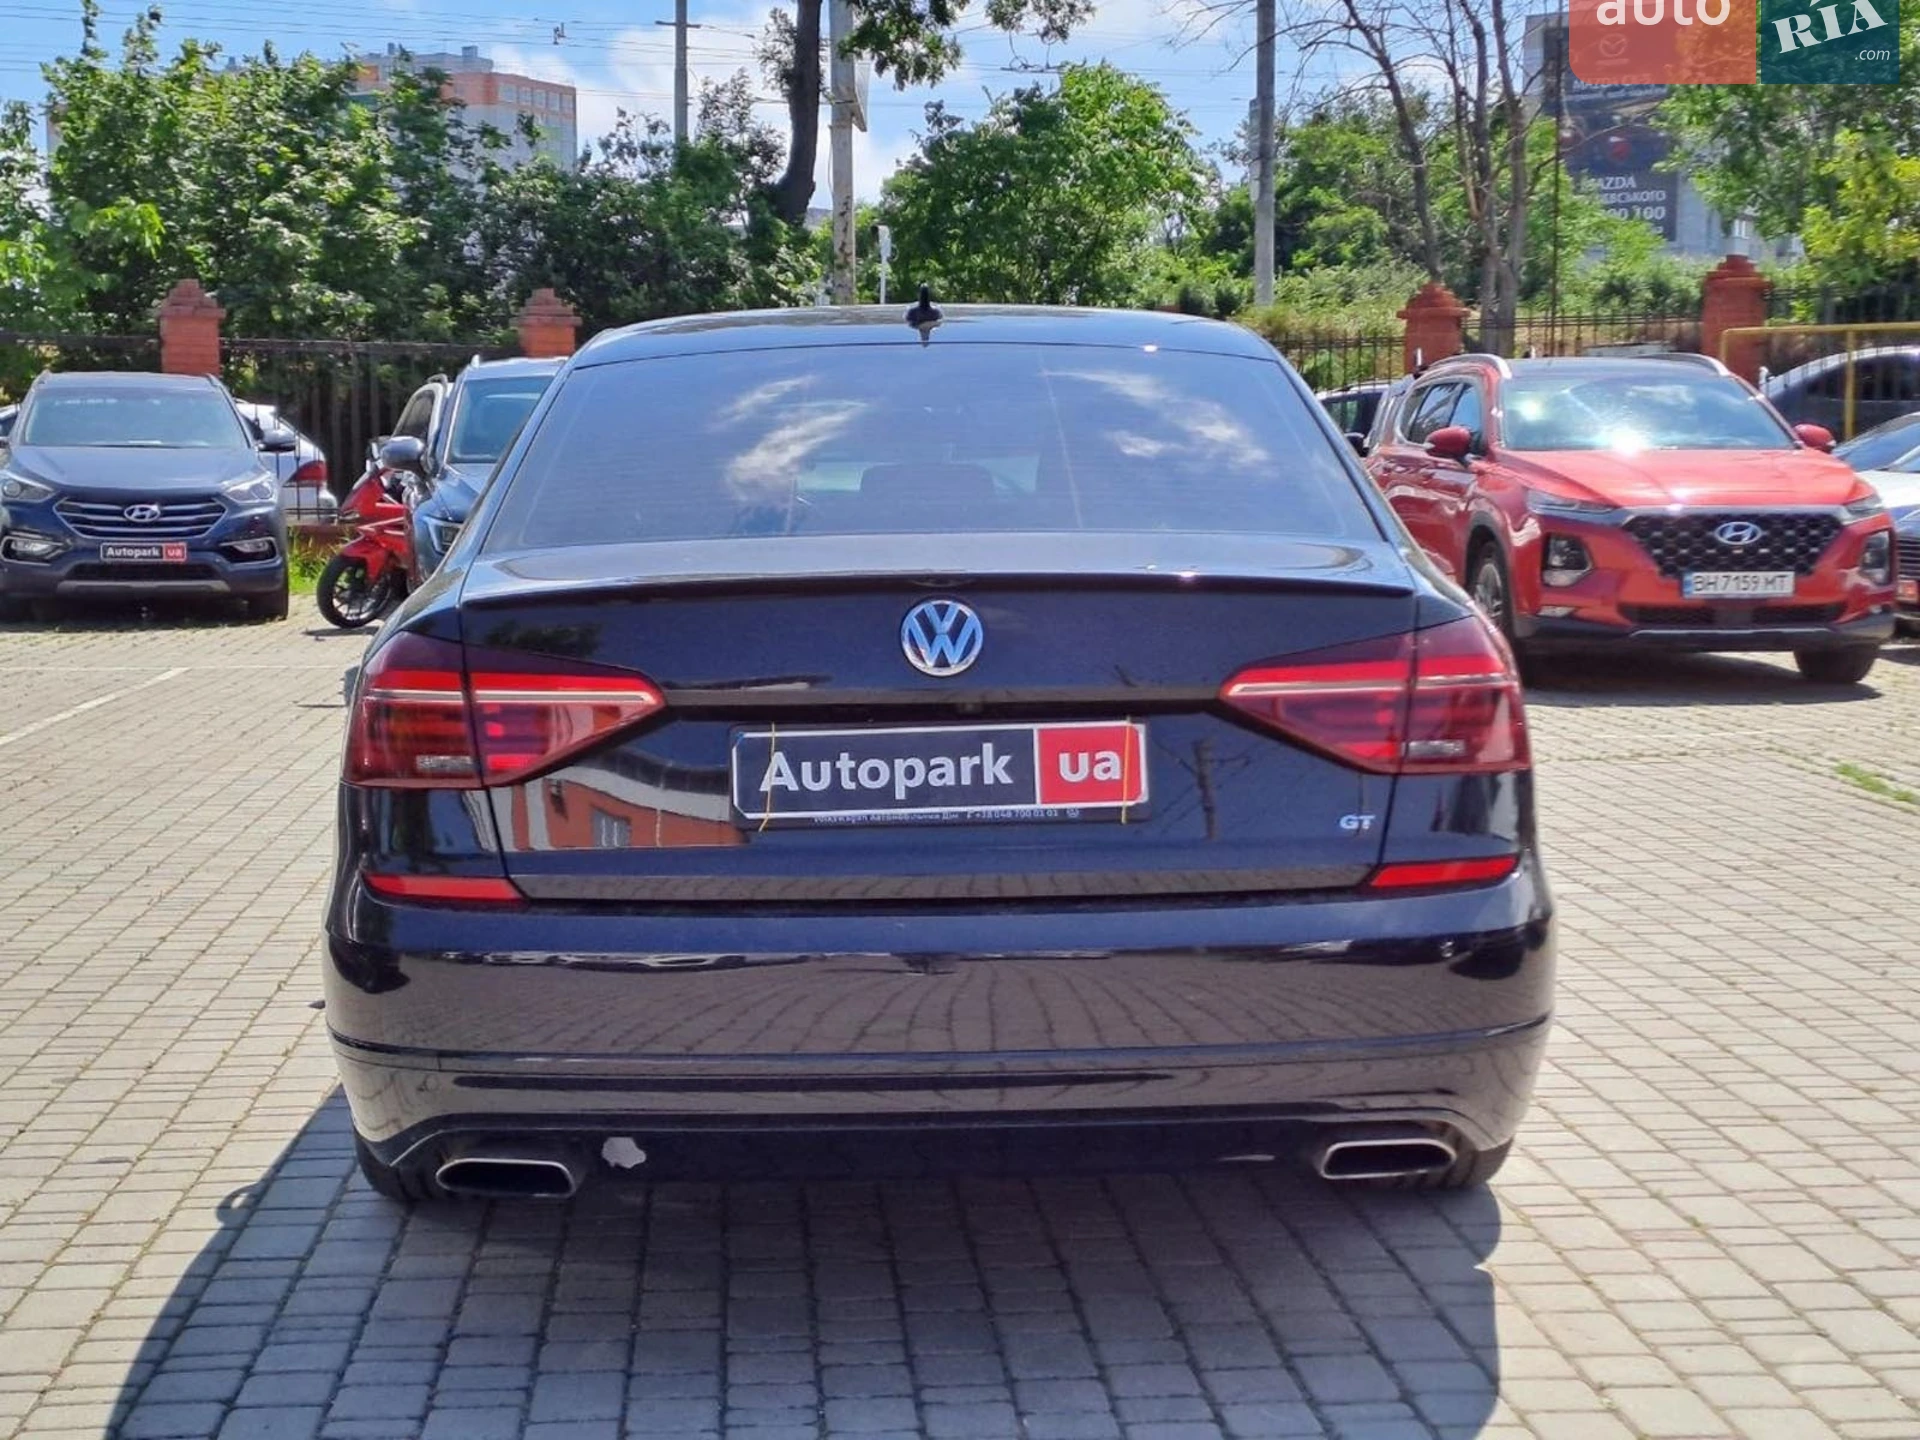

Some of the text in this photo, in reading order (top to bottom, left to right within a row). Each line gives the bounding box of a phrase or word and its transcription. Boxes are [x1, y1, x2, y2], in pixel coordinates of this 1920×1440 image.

[106, 547, 183, 558] Autopark ua
[1721, 574, 1759, 592] 7159
[758, 742, 1122, 800] Autopark ua
[1340, 814, 1376, 830] GT
